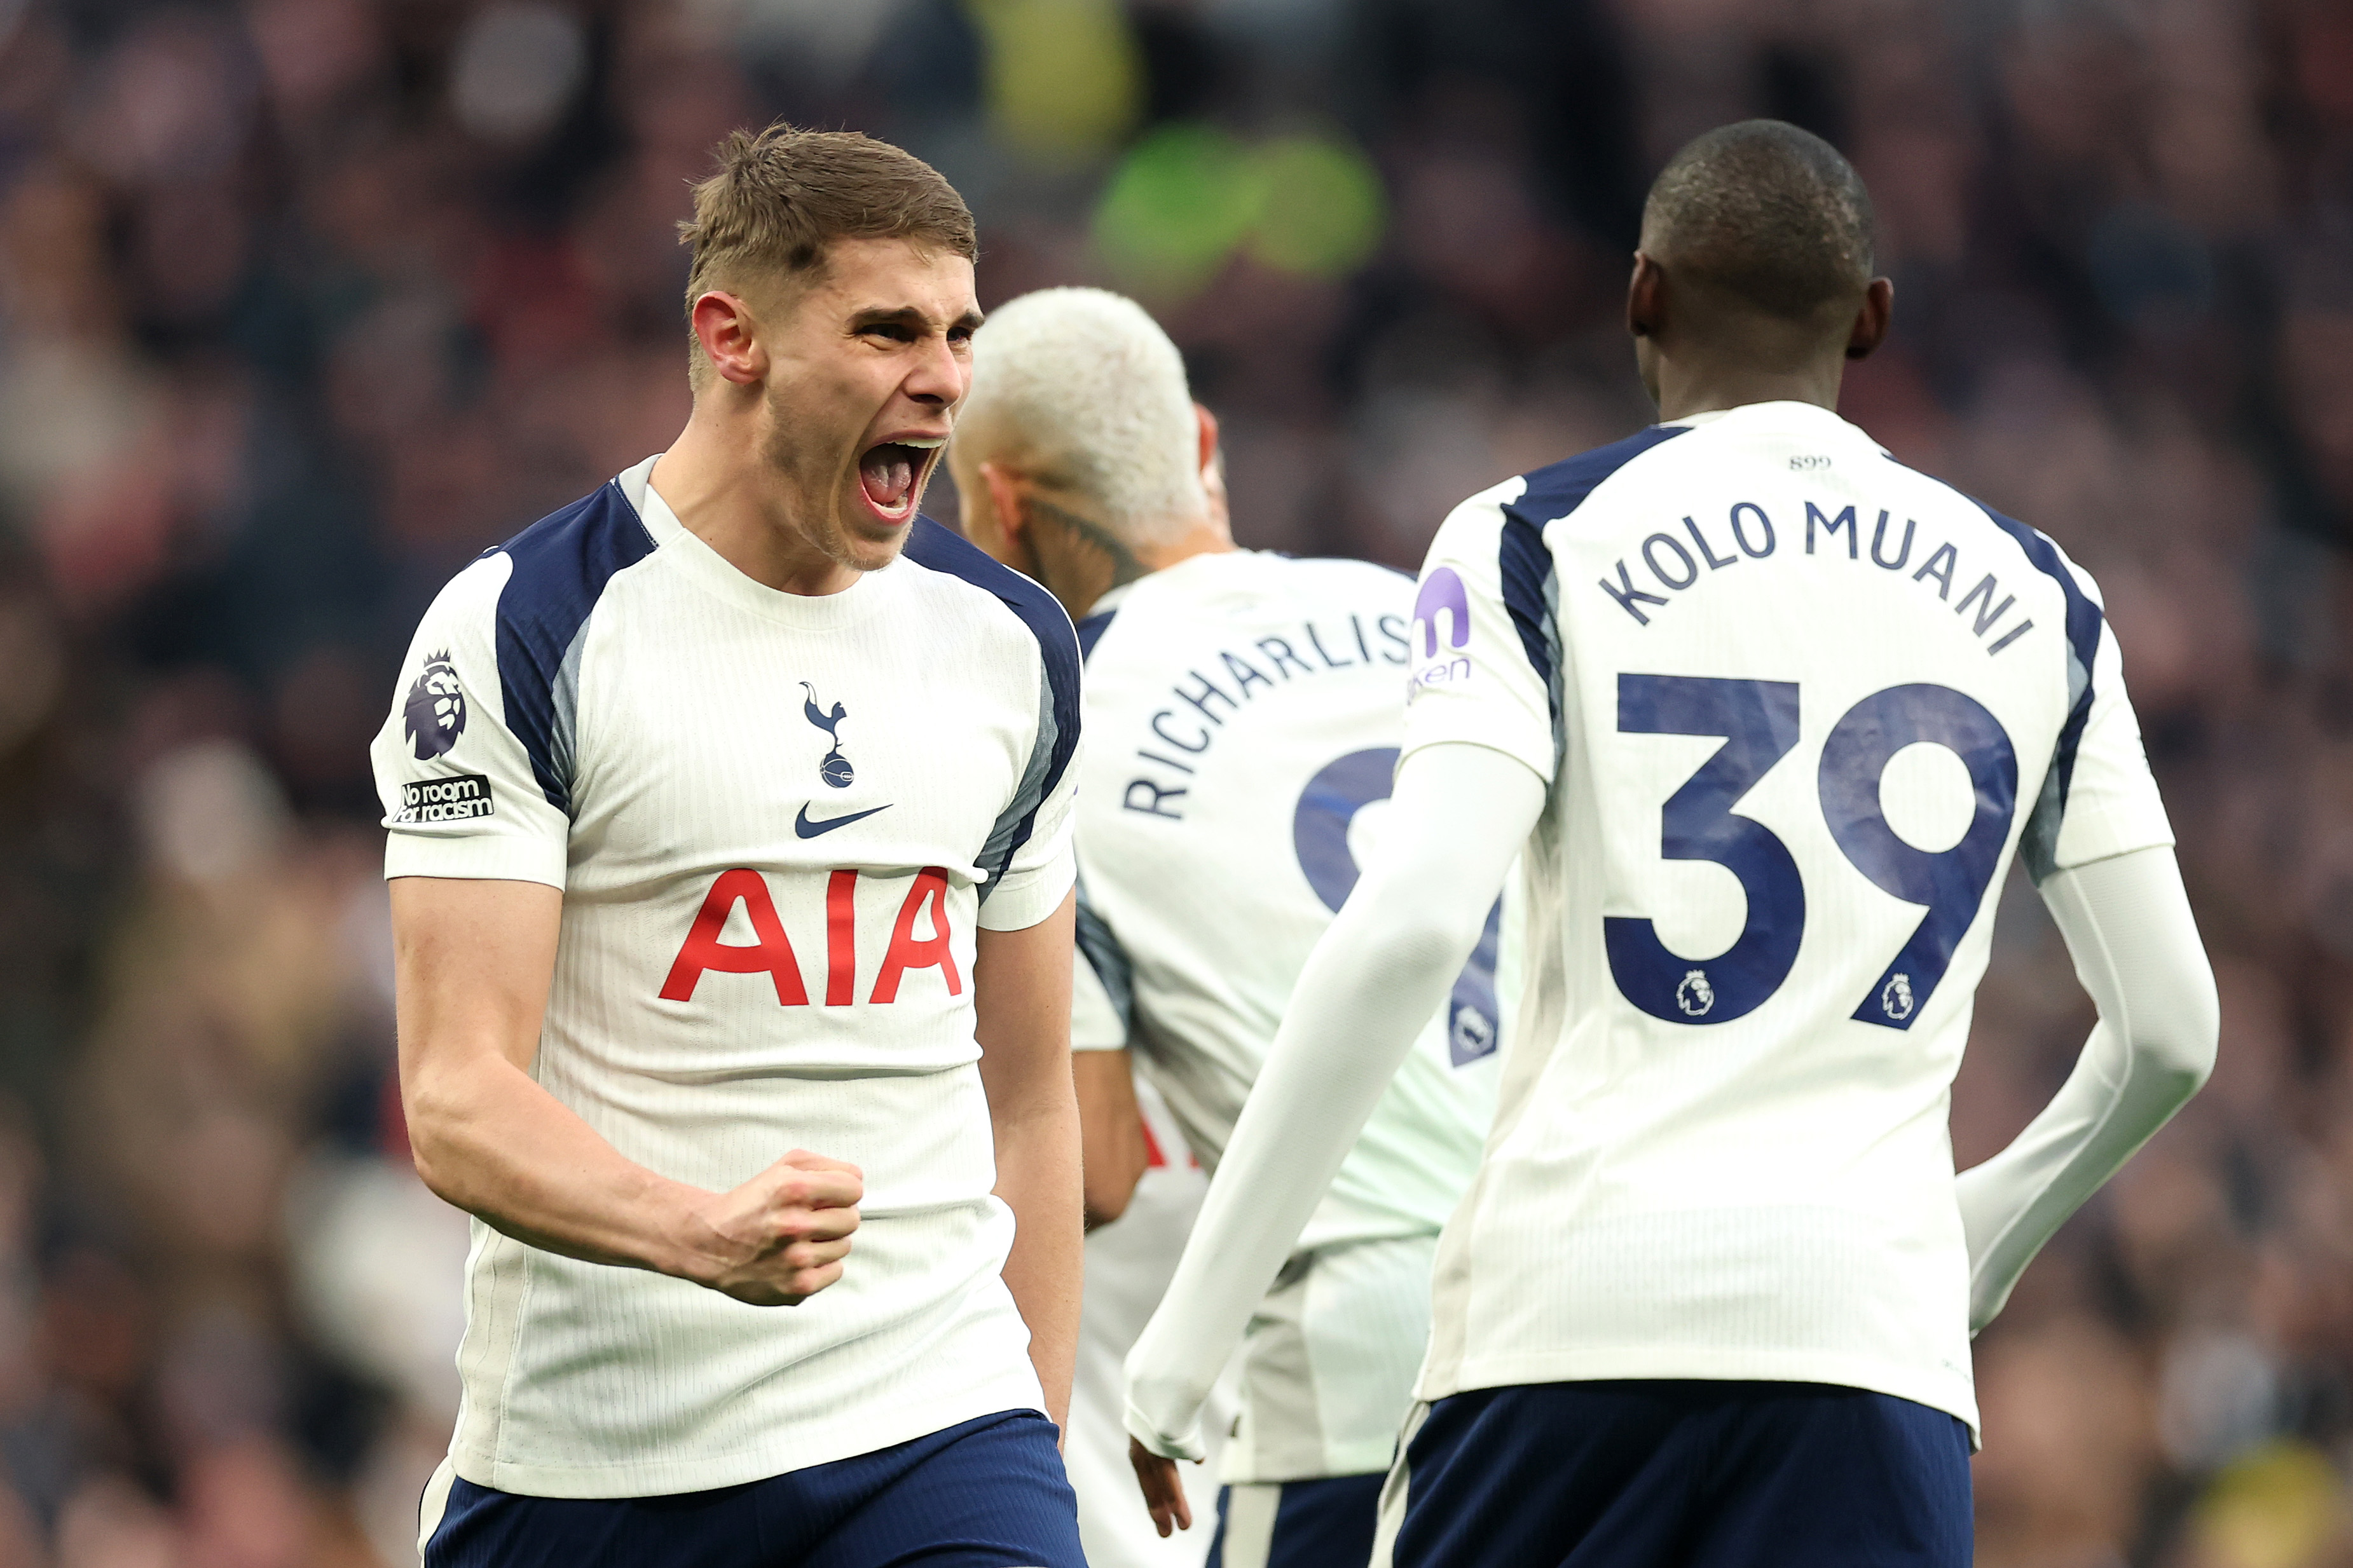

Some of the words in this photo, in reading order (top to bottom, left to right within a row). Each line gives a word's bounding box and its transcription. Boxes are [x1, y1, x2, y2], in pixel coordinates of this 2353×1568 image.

[1789, 455, 1832, 471] 899
[1599, 501, 1776, 626] KOLO
[1804, 501, 2033, 657] MUANI
[1122, 613, 1411, 821] RICHARLIS
[1408, 657, 1470, 699] ken
[401, 784, 420, 806] No
[422, 779, 480, 803] room
[421, 797, 493, 822] racism
[1603, 672, 2019, 1031] 39
[658, 866, 963, 1007] AIA
